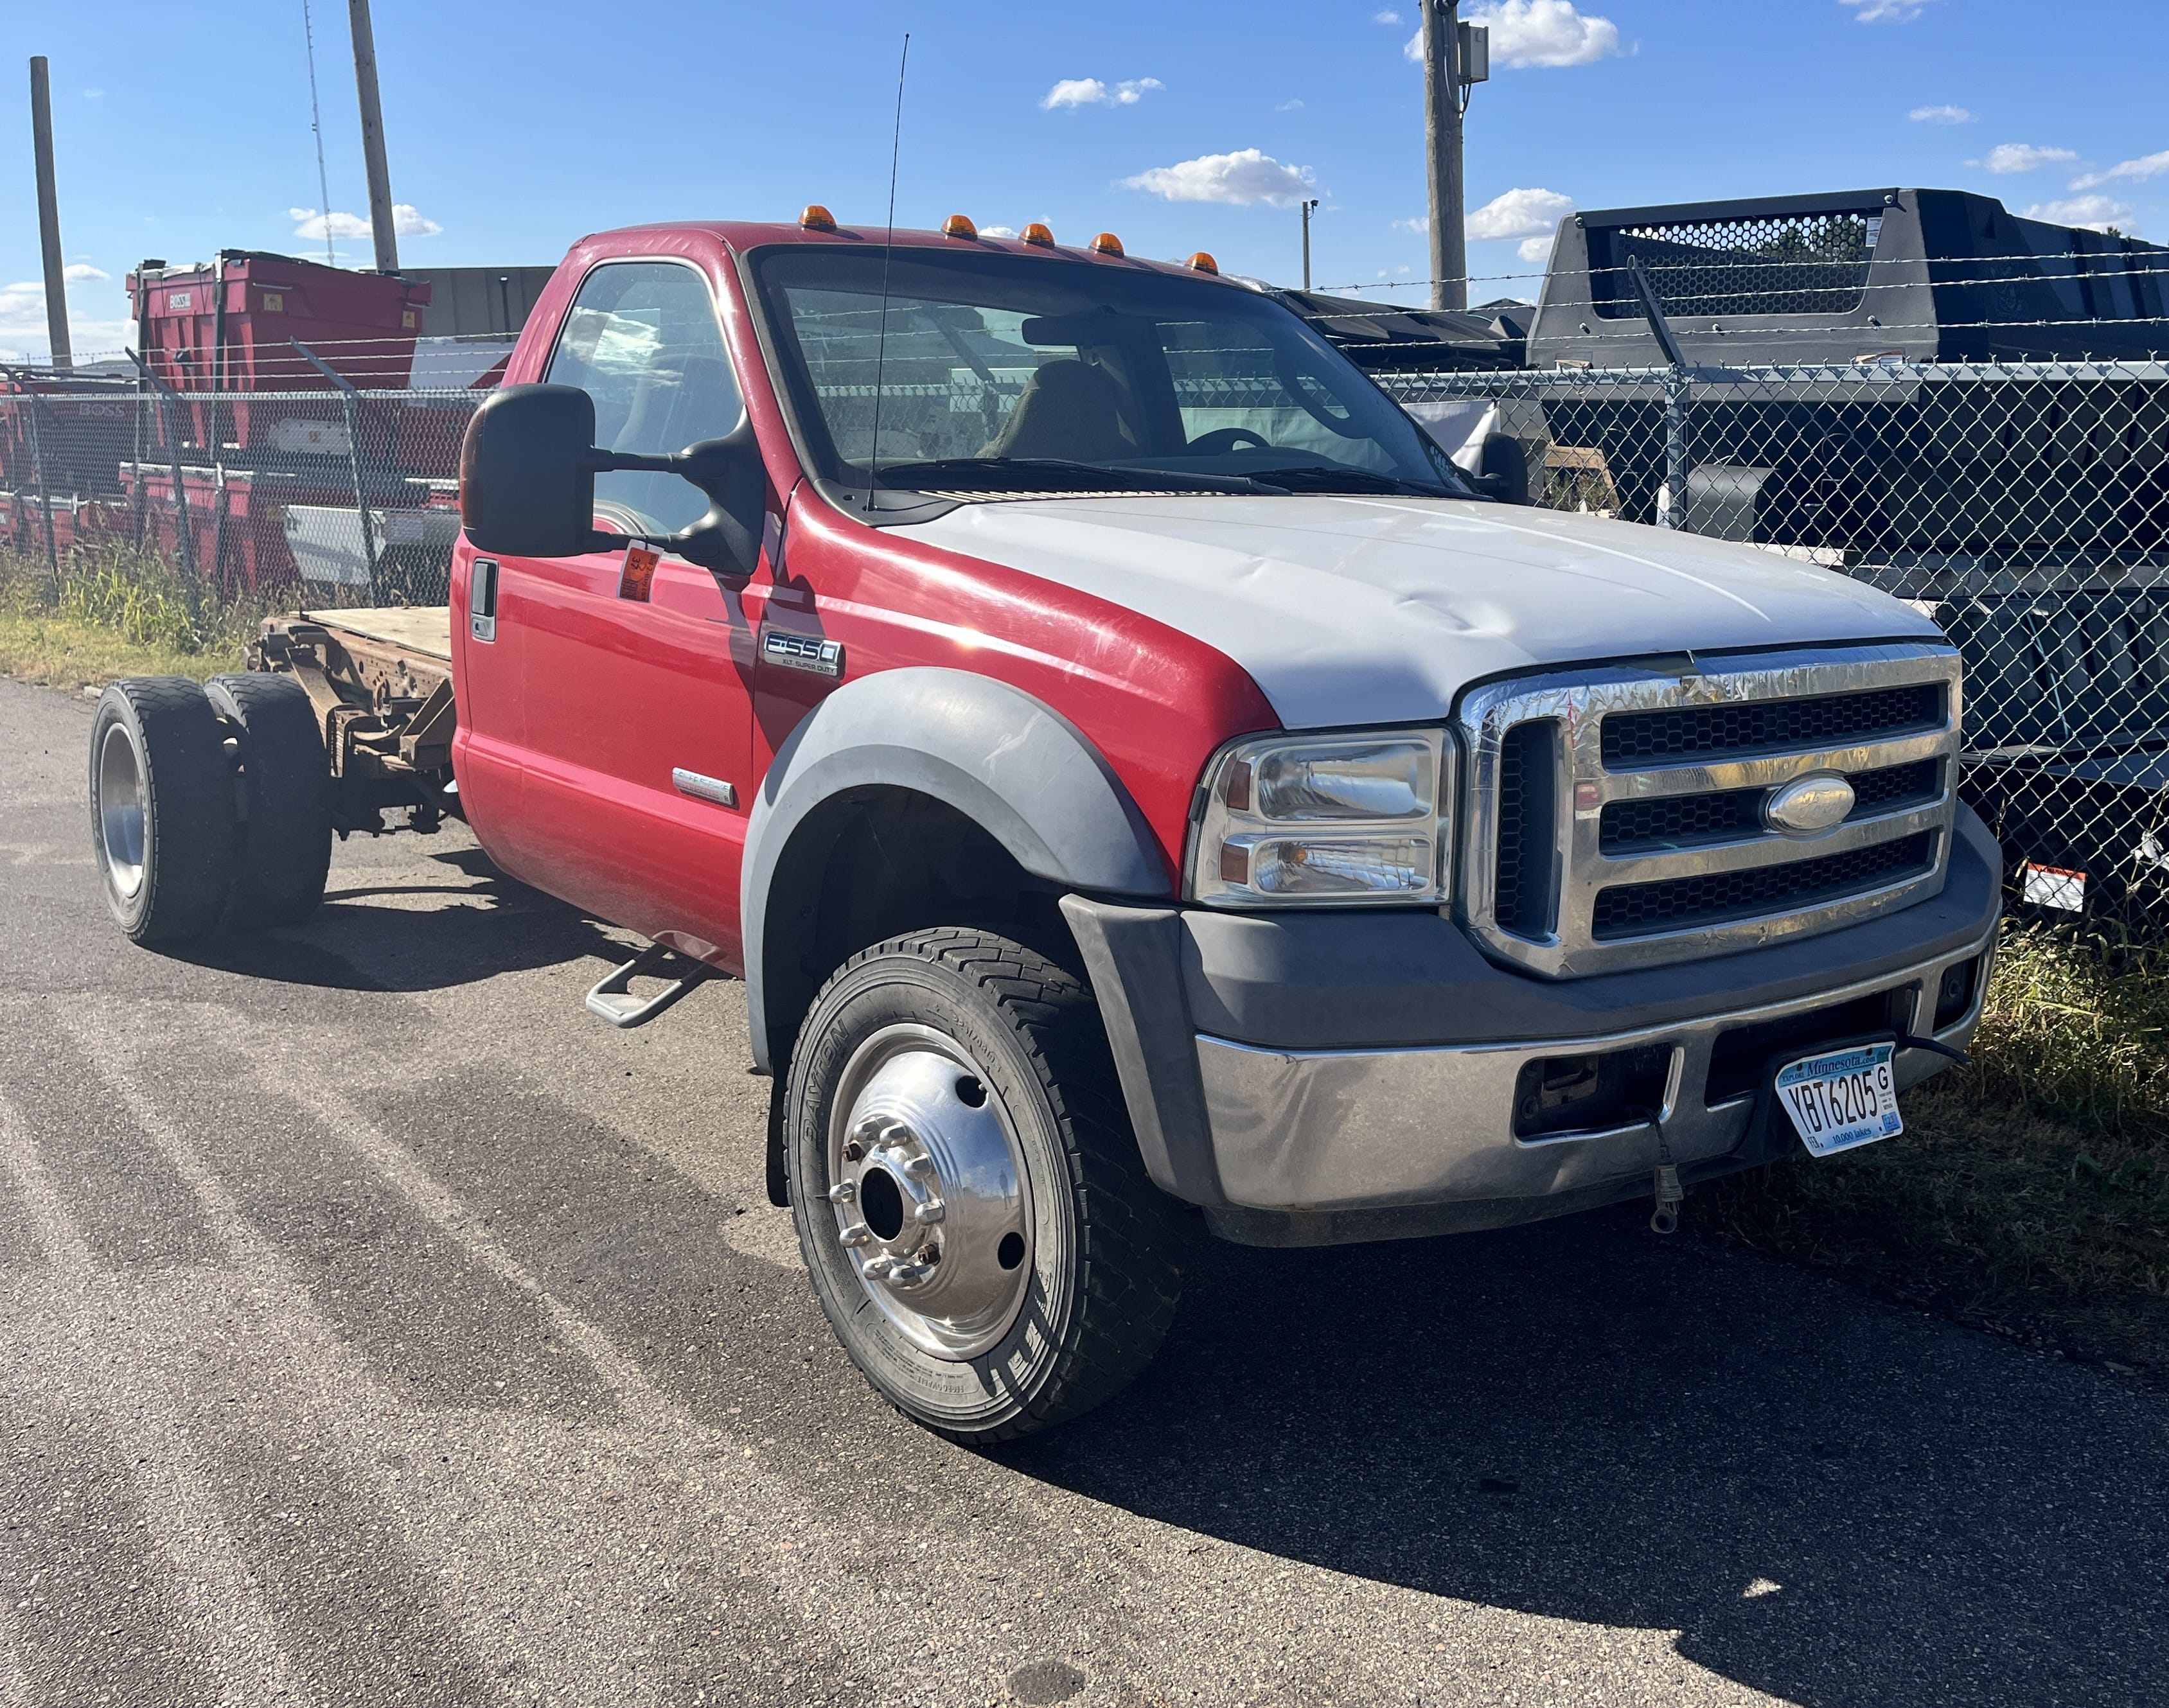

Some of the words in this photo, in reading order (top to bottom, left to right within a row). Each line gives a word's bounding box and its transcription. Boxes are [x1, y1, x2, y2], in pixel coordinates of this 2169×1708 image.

[170, 294, 186, 309] BOSS
[79, 403, 125, 416] BOSS
[631, 556, 641, 570] 37
[795, 660, 817, 670] SUPER
[802, 1017, 849, 1150] DAYTON
[1877, 1066, 1889, 1090] G
[1807, 1136, 1820, 1149] FEB
[1832, 1131, 1854, 1144] 10,000
[1854, 1127, 1872, 1138] lakes
